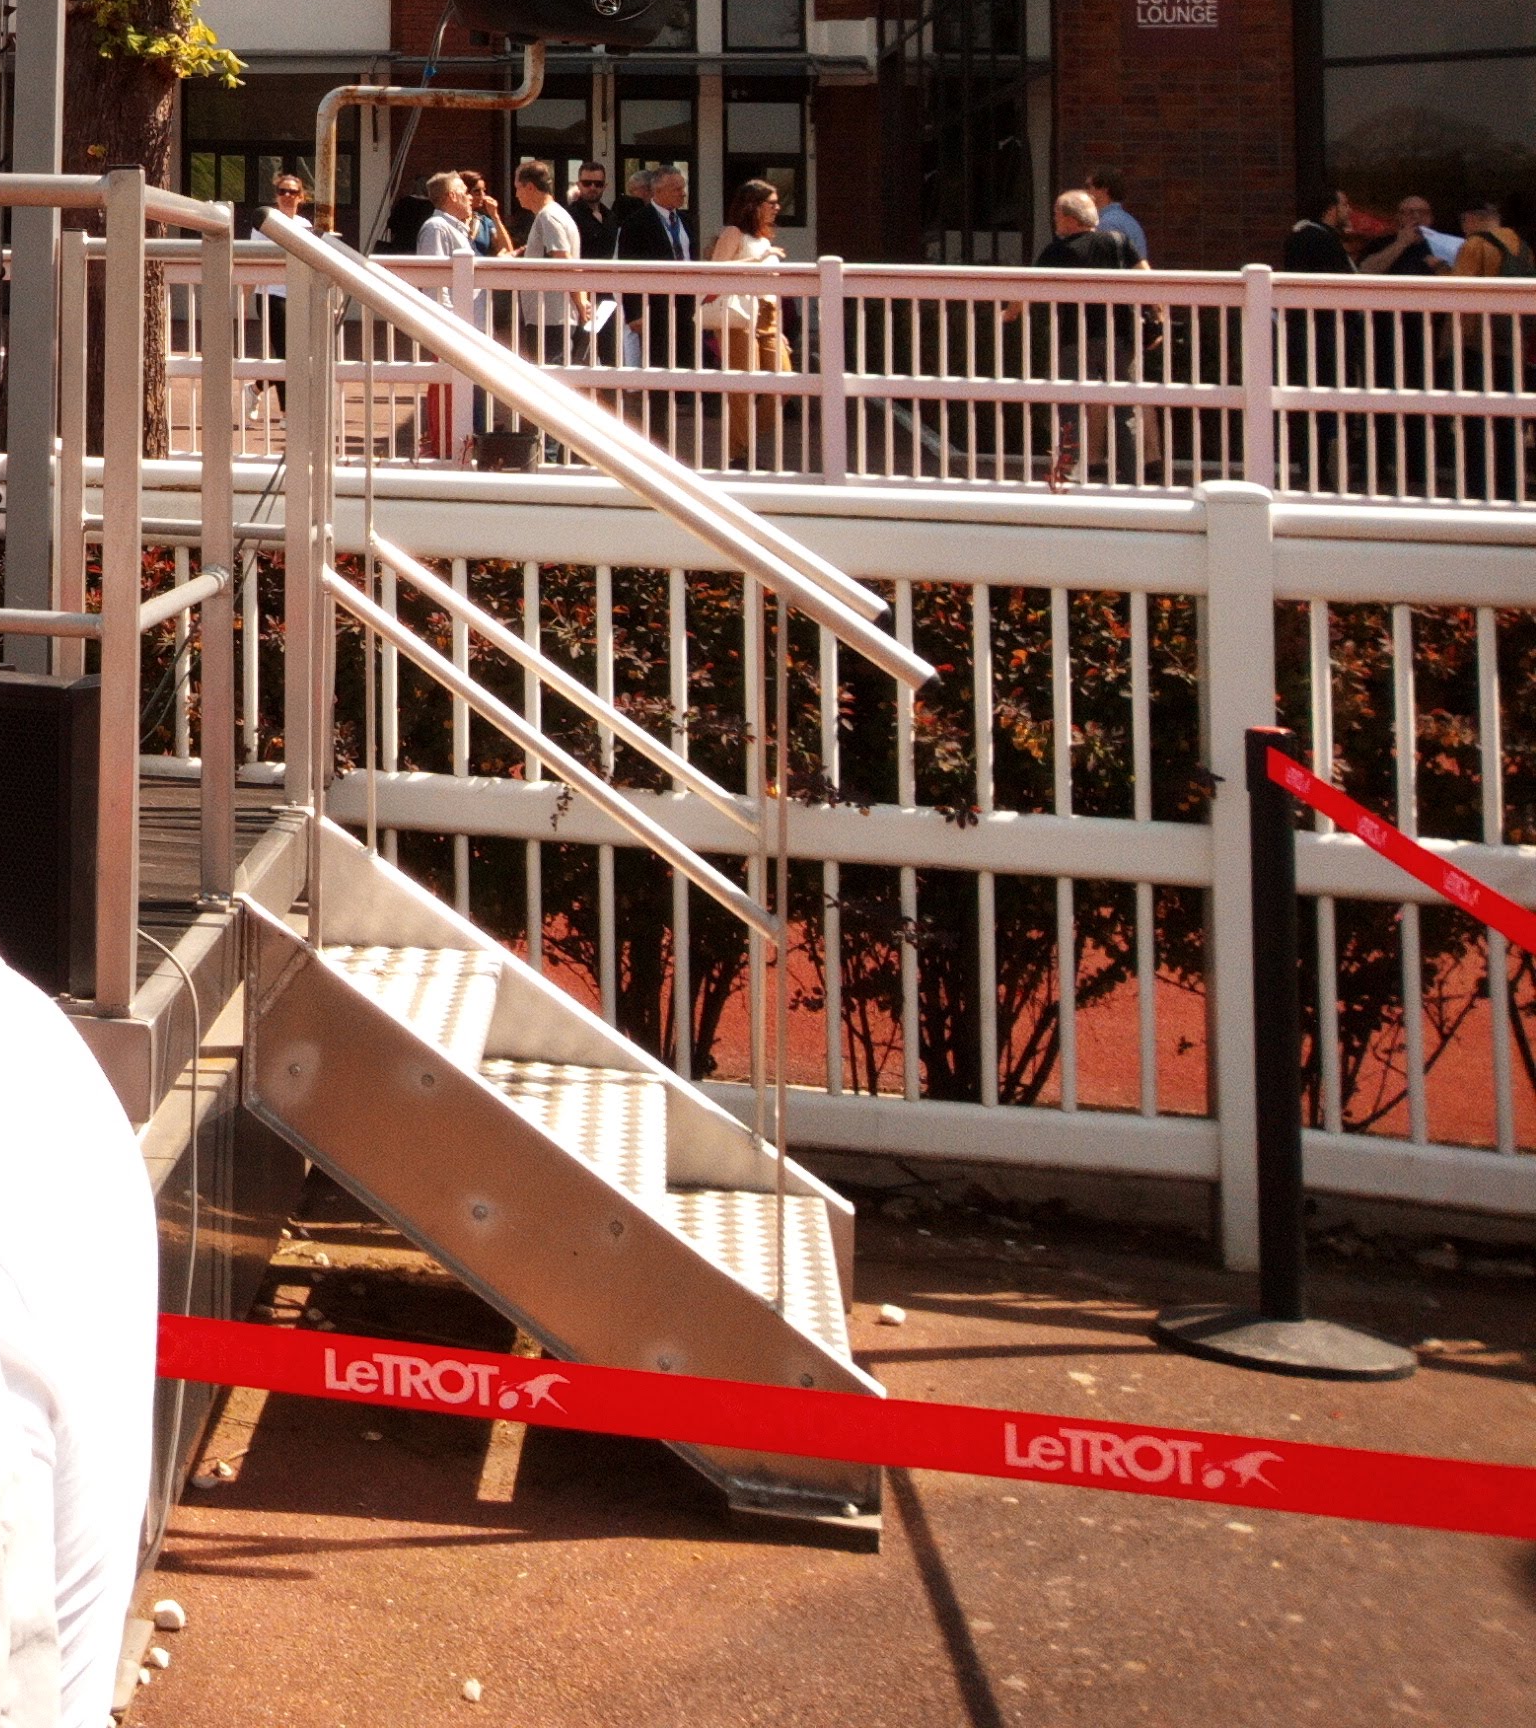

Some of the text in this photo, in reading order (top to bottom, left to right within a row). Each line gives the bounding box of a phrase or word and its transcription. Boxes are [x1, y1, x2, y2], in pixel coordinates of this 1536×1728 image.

[1137, 6, 1217, 23] LOUNGE
[325, 1349, 497, 1405] LeTROT
[1004, 1422, 1201, 1484] LeTROT
